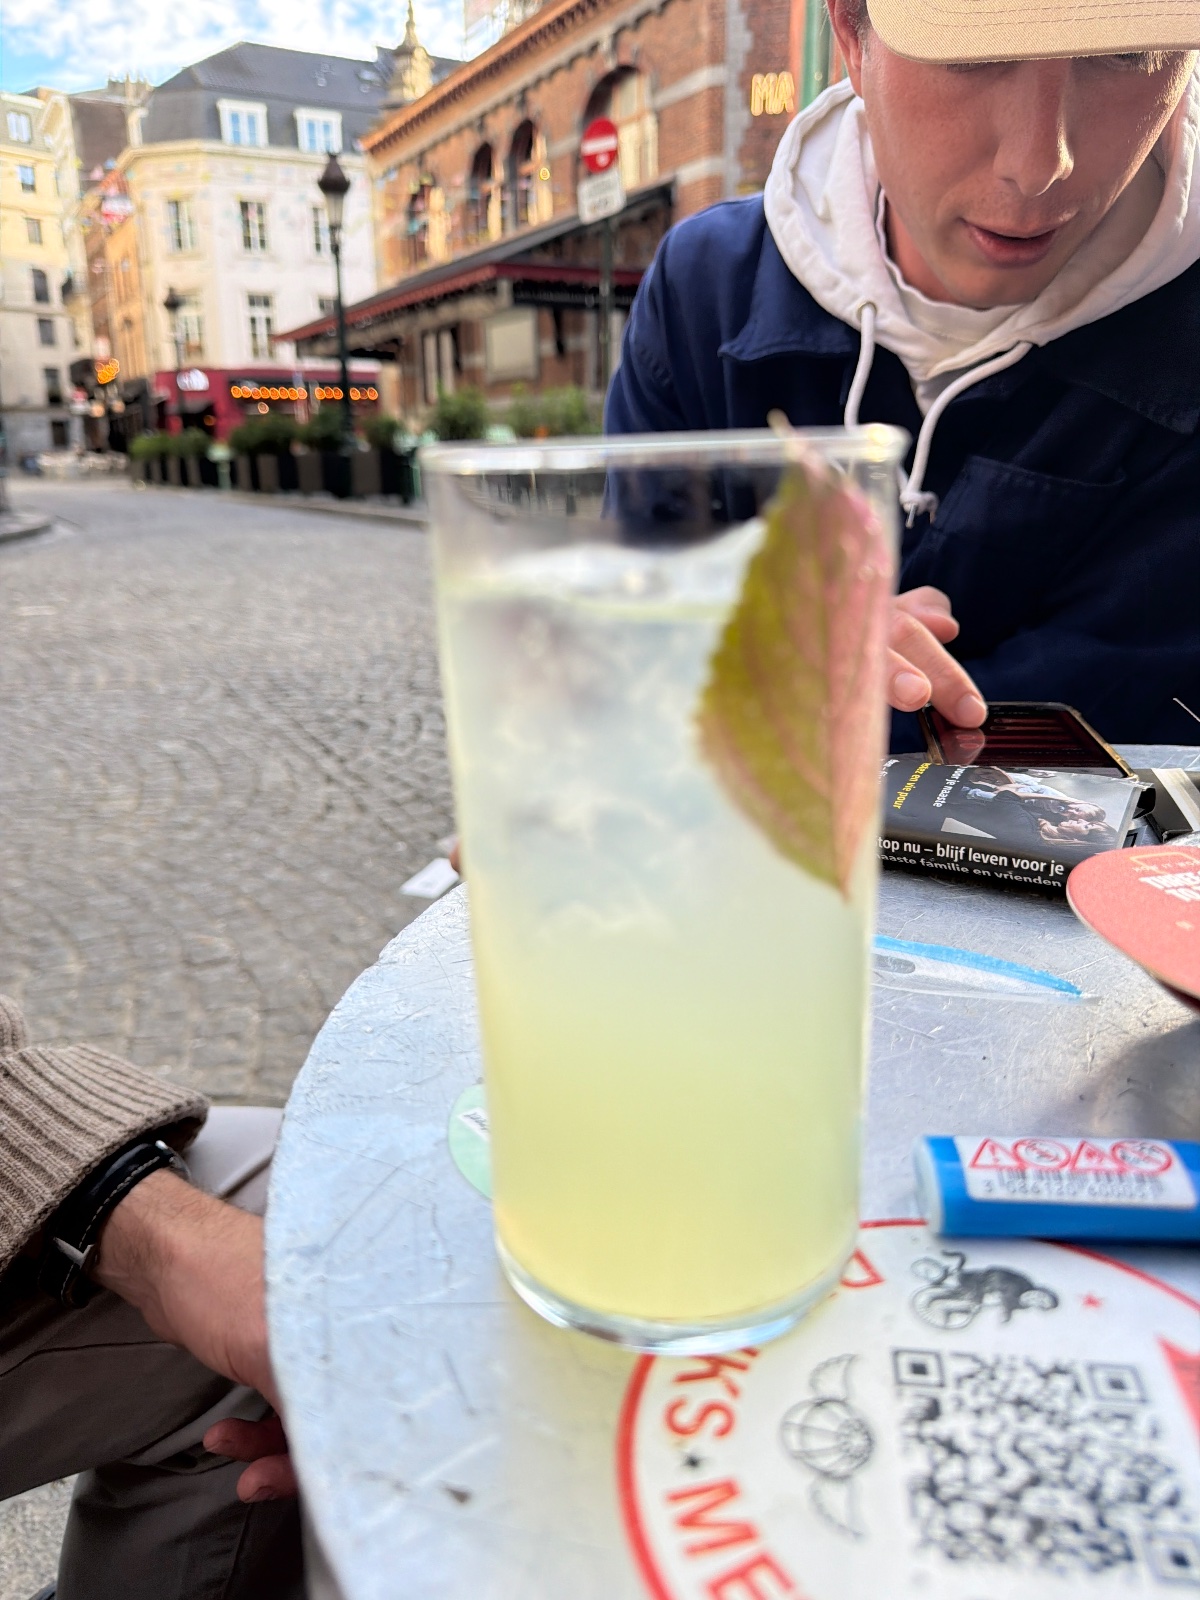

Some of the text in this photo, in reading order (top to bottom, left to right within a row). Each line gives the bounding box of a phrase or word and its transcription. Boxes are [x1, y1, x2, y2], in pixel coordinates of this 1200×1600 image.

[902, 782, 916, 792] vie
[945, 778, 960, 786] je
[893, 791, 909, 809] pour
[933, 785, 954, 808] naaste
[877, 836, 900, 853] top
[903, 842, 921, 854] nu
[936, 842, 966, 863] blijf
[968, 847, 1008, 867] leven
[1011, 857, 1047, 872] voor
[1048, 860, 1065, 877] je
[920, 858, 970, 873] familie
[972, 868, 991, 877] en
[994, 871, 1062, 888] vrienden
